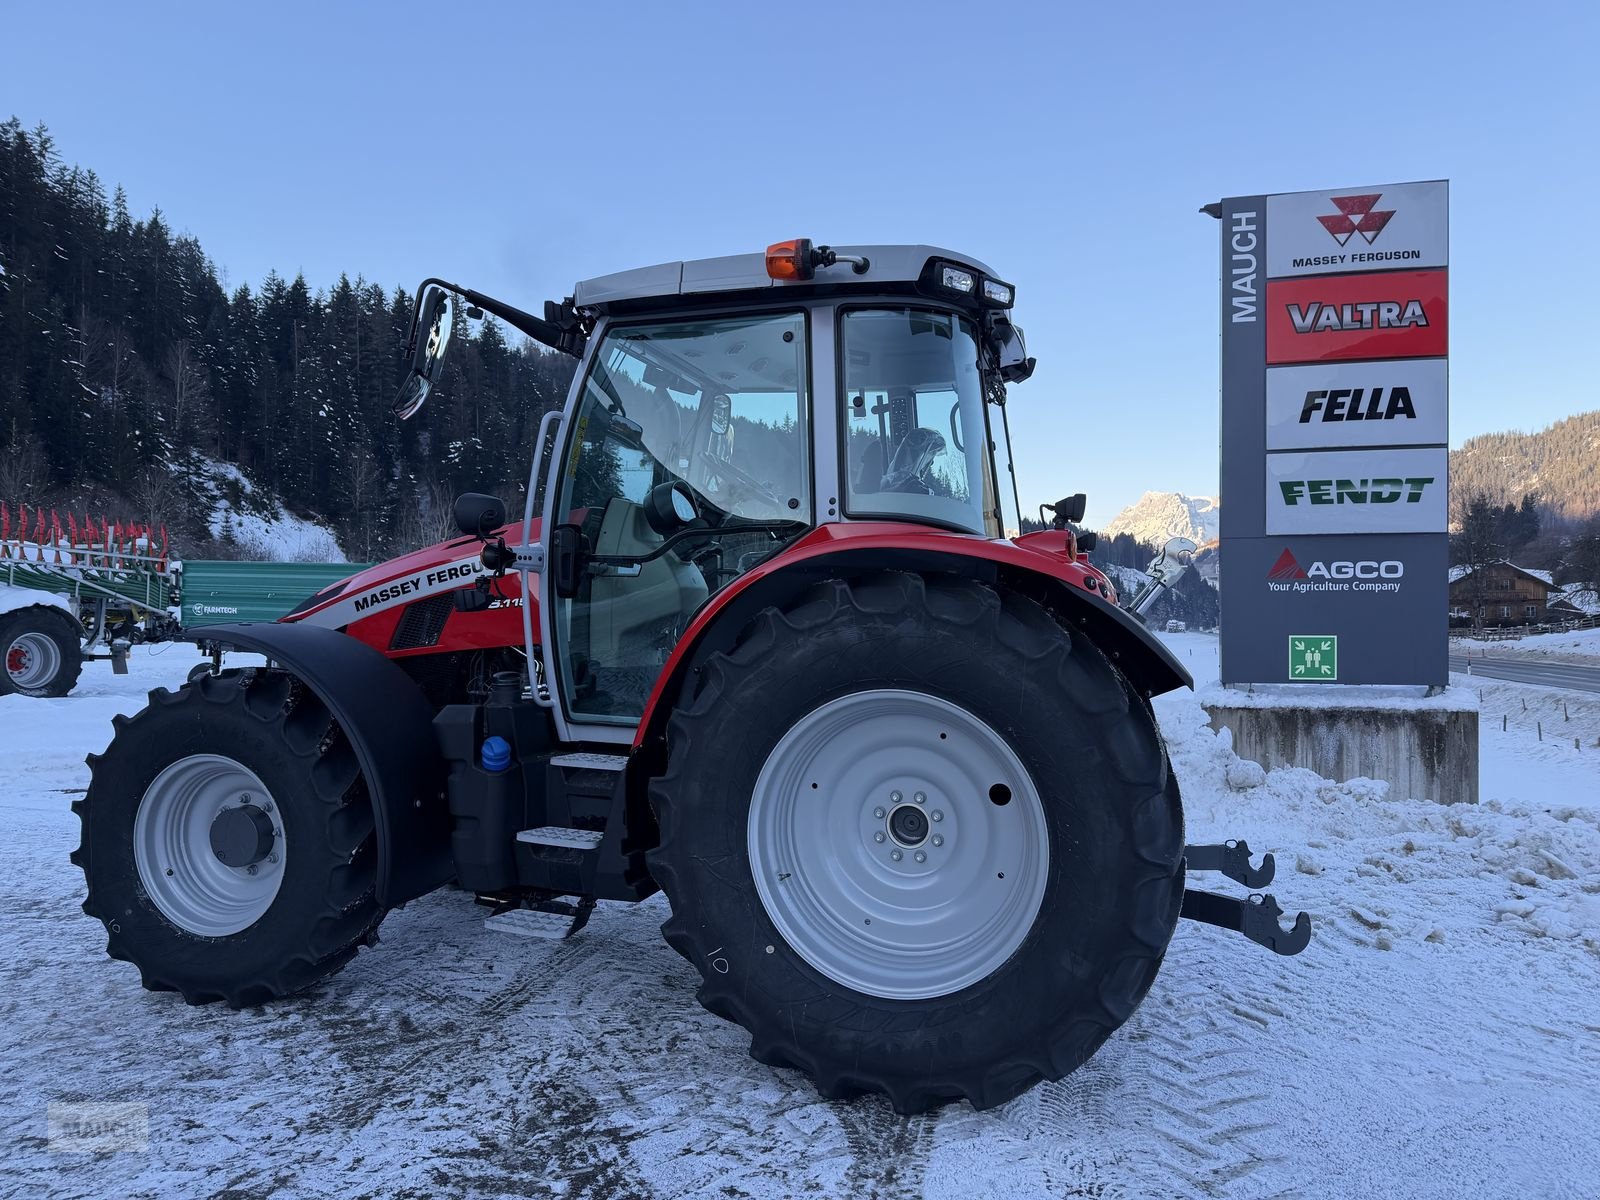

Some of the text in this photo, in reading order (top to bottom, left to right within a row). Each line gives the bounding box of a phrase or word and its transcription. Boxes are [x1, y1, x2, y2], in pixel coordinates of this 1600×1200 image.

[1232, 211, 1257, 323] MAUCH
[1292, 250, 1420, 268] MASSEY FERGUSON
[1286, 300, 1429, 334] VALTRA
[1299, 387, 1416, 423] FELLA
[1279, 478, 1434, 506] FENDT
[1307, 560, 1404, 579] AGCO
[354, 561, 484, 612] MASSEY FERGU
[1268, 581, 1400, 594] Your Agriculture Company
